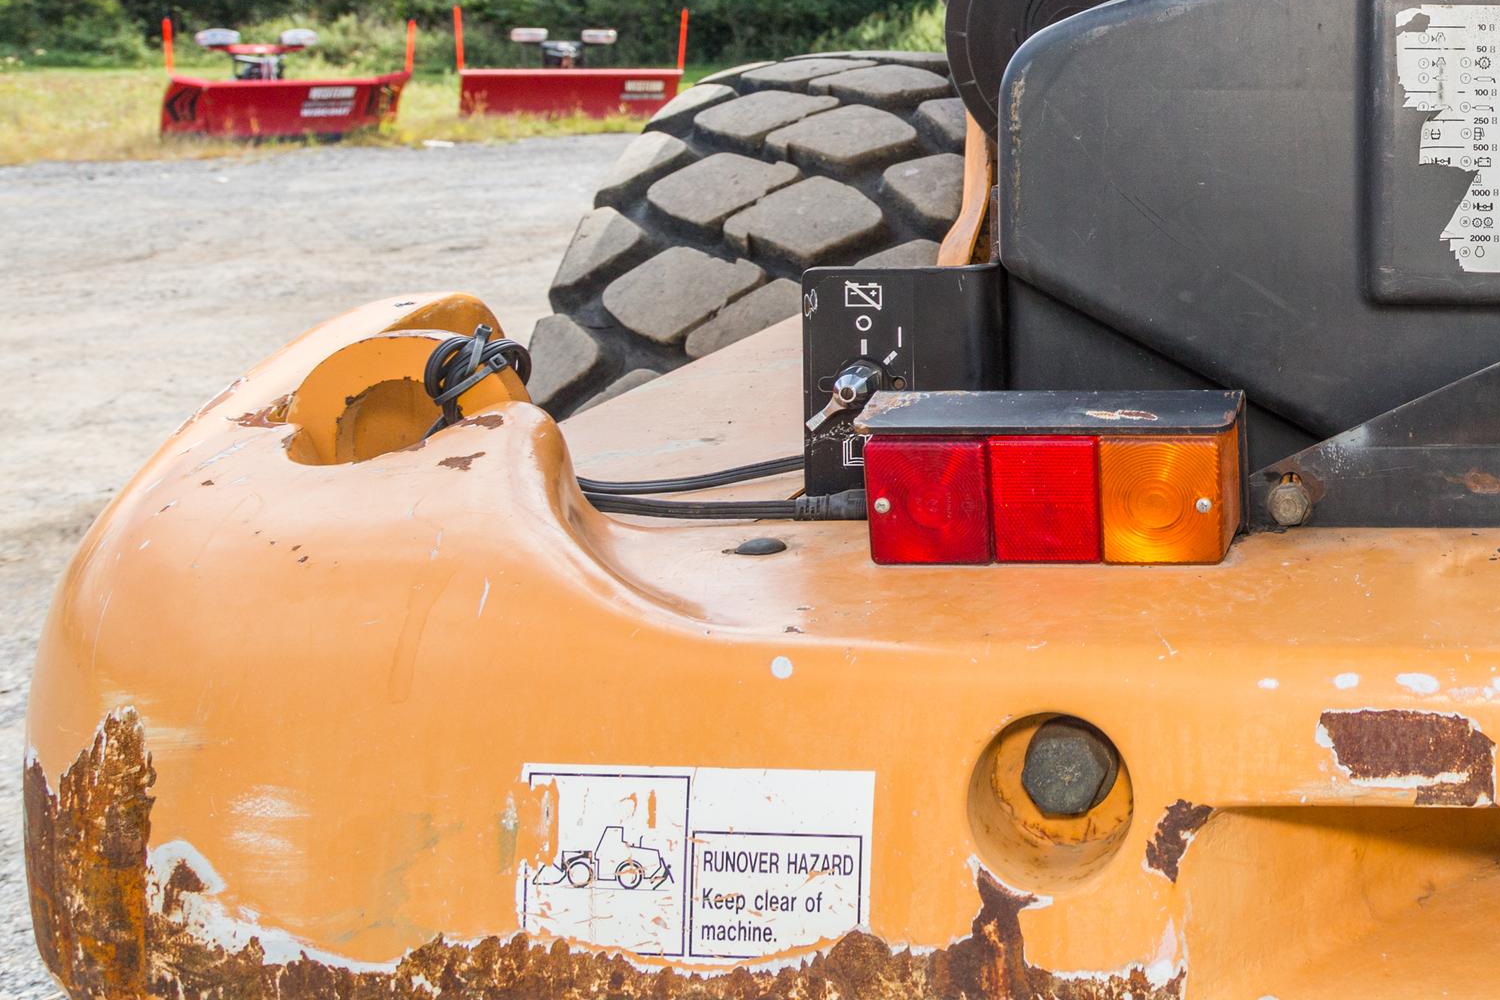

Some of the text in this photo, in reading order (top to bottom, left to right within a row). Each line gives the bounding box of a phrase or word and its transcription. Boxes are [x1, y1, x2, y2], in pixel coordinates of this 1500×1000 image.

[1477, 23, 1487, 31] 10
[1476, 45, 1488, 53] 50
[1474, 88, 1489, 97] 100
[1473, 117, 1490, 125] 250
[1473, 143, 1490, 152] 500
[1471, 189, 1491, 197] 1000
[1469, 234, 1491, 242] 2000
[703, 850, 854, 876] RUNOVER HAZARD
[703, 888, 822, 914] Keep clear of
[702, 920, 777, 943] machine.
